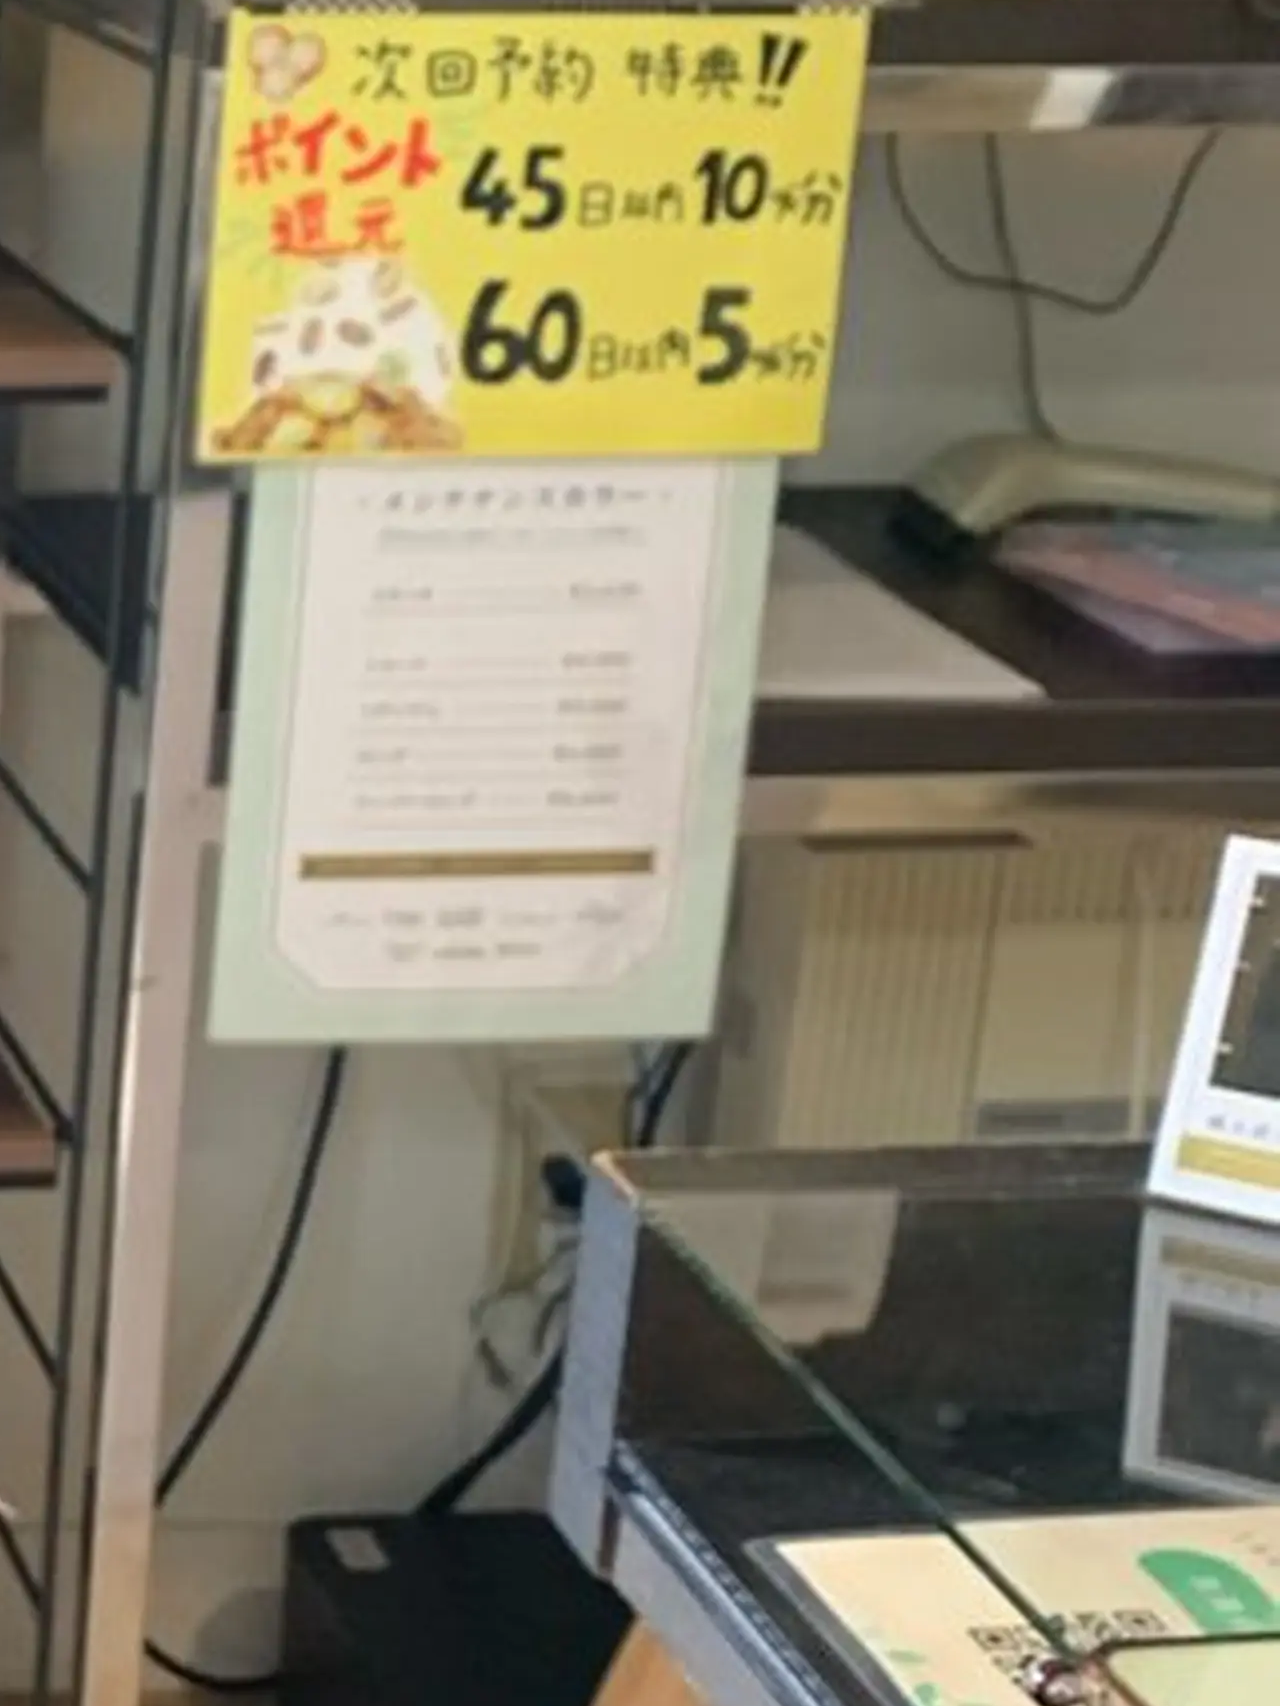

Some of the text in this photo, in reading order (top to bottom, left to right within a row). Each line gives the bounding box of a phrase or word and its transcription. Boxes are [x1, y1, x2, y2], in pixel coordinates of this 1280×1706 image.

[349, 35, 597, 105] 次回予約
[233, 111, 444, 187] ポイント
